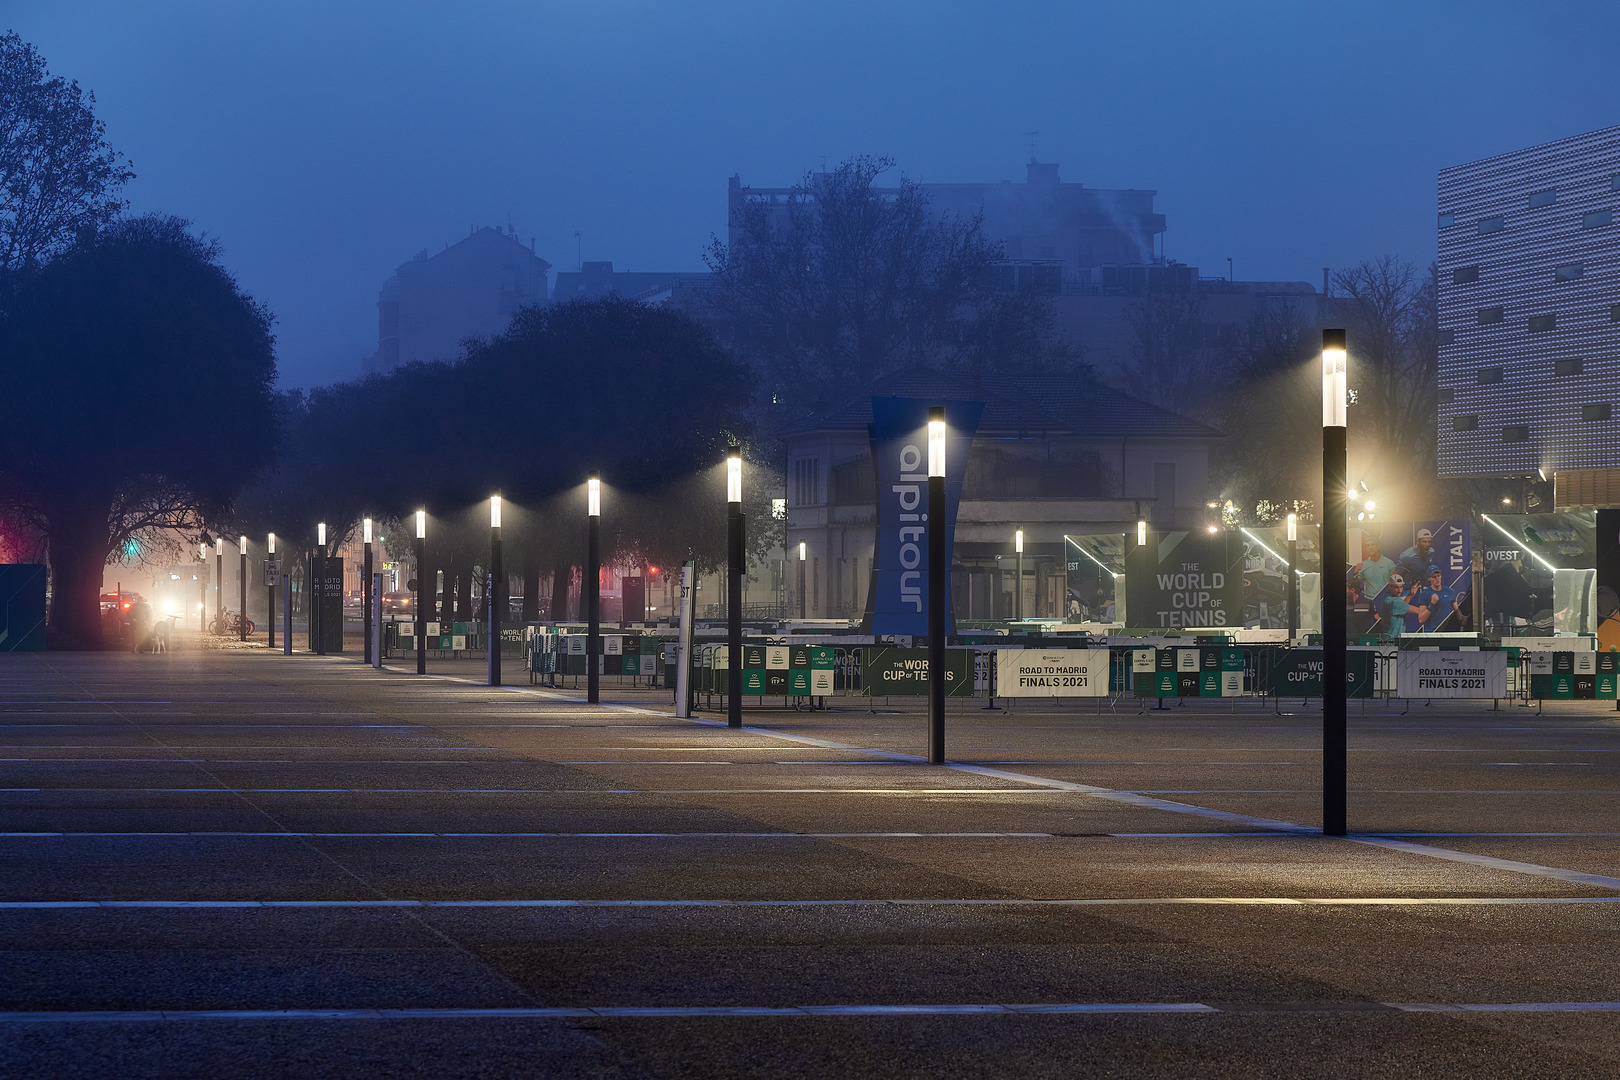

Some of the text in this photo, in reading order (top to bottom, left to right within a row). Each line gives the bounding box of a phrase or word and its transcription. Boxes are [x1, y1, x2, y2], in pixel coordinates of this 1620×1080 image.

[892, 444, 929, 613] alpitour
[1449, 526, 1463, 571] ITALY
[1486, 550, 1519, 561] OVEST
[1067, 562, 1079, 571] EST
[1181, 562, 1200, 571] THE
[1245, 558, 1266, 568] NORD
[1157, 573, 1225, 590] WORLD
[1172, 591, 1223, 609] CUP OF
[1156, 609, 1227, 628] TENNIS
[904, 659, 930, 670] WOR
[883, 670, 905, 681] CUP
[1287, 671, 1309, 682] CUP
[1419, 668, 1486, 676] ROAD TO MADRID
[1019, 677, 1088, 687] FINALS 2021
[1419, 679, 1486, 689] FINALS 2021
